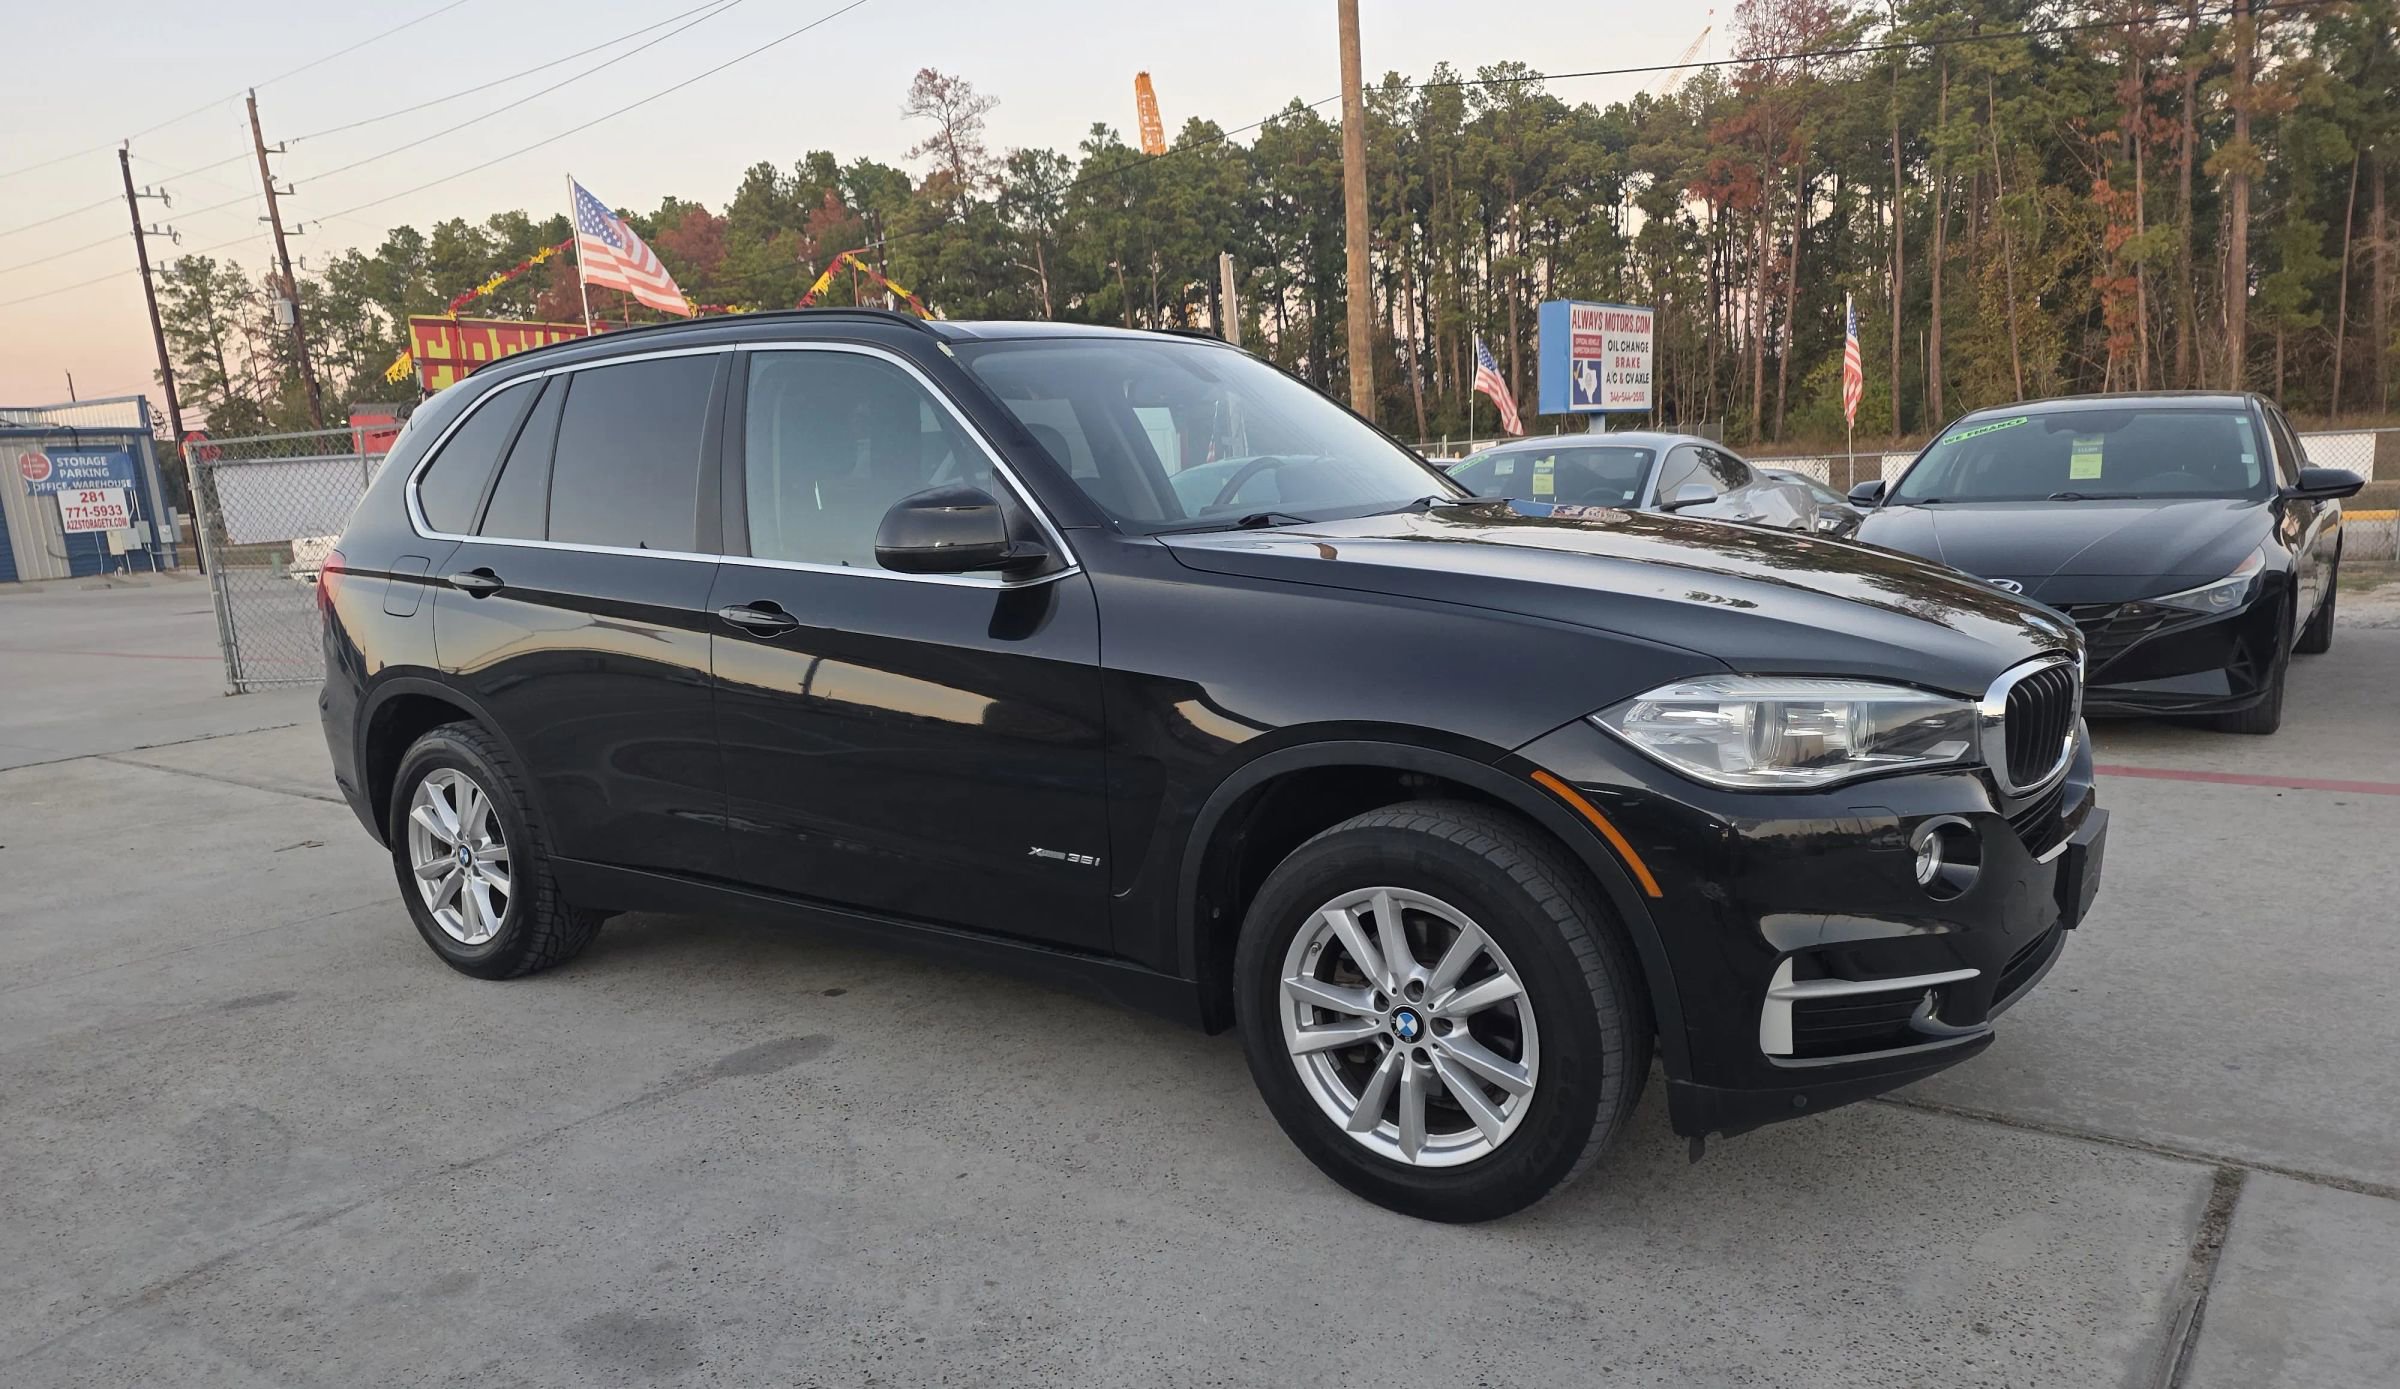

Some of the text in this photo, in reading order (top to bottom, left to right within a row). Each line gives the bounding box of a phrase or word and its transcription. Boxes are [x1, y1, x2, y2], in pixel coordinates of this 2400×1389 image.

[1572, 309, 1651, 334] ALWAYS MOTORS.COM
[1607, 339, 1620, 352] OIL
[1620, 340, 1649, 353] CHANGE
[1615, 356, 1641, 369] BRAKE
[1967, 417, 2026, 437] FINANCE
[56, 456, 108, 467] STORAGE
[60, 468, 110, 479] PARKING
[72, 479, 132, 489] WAREHOUSE
[79, 491, 106, 503] 281
[65, 505, 123, 518] 771-5933
